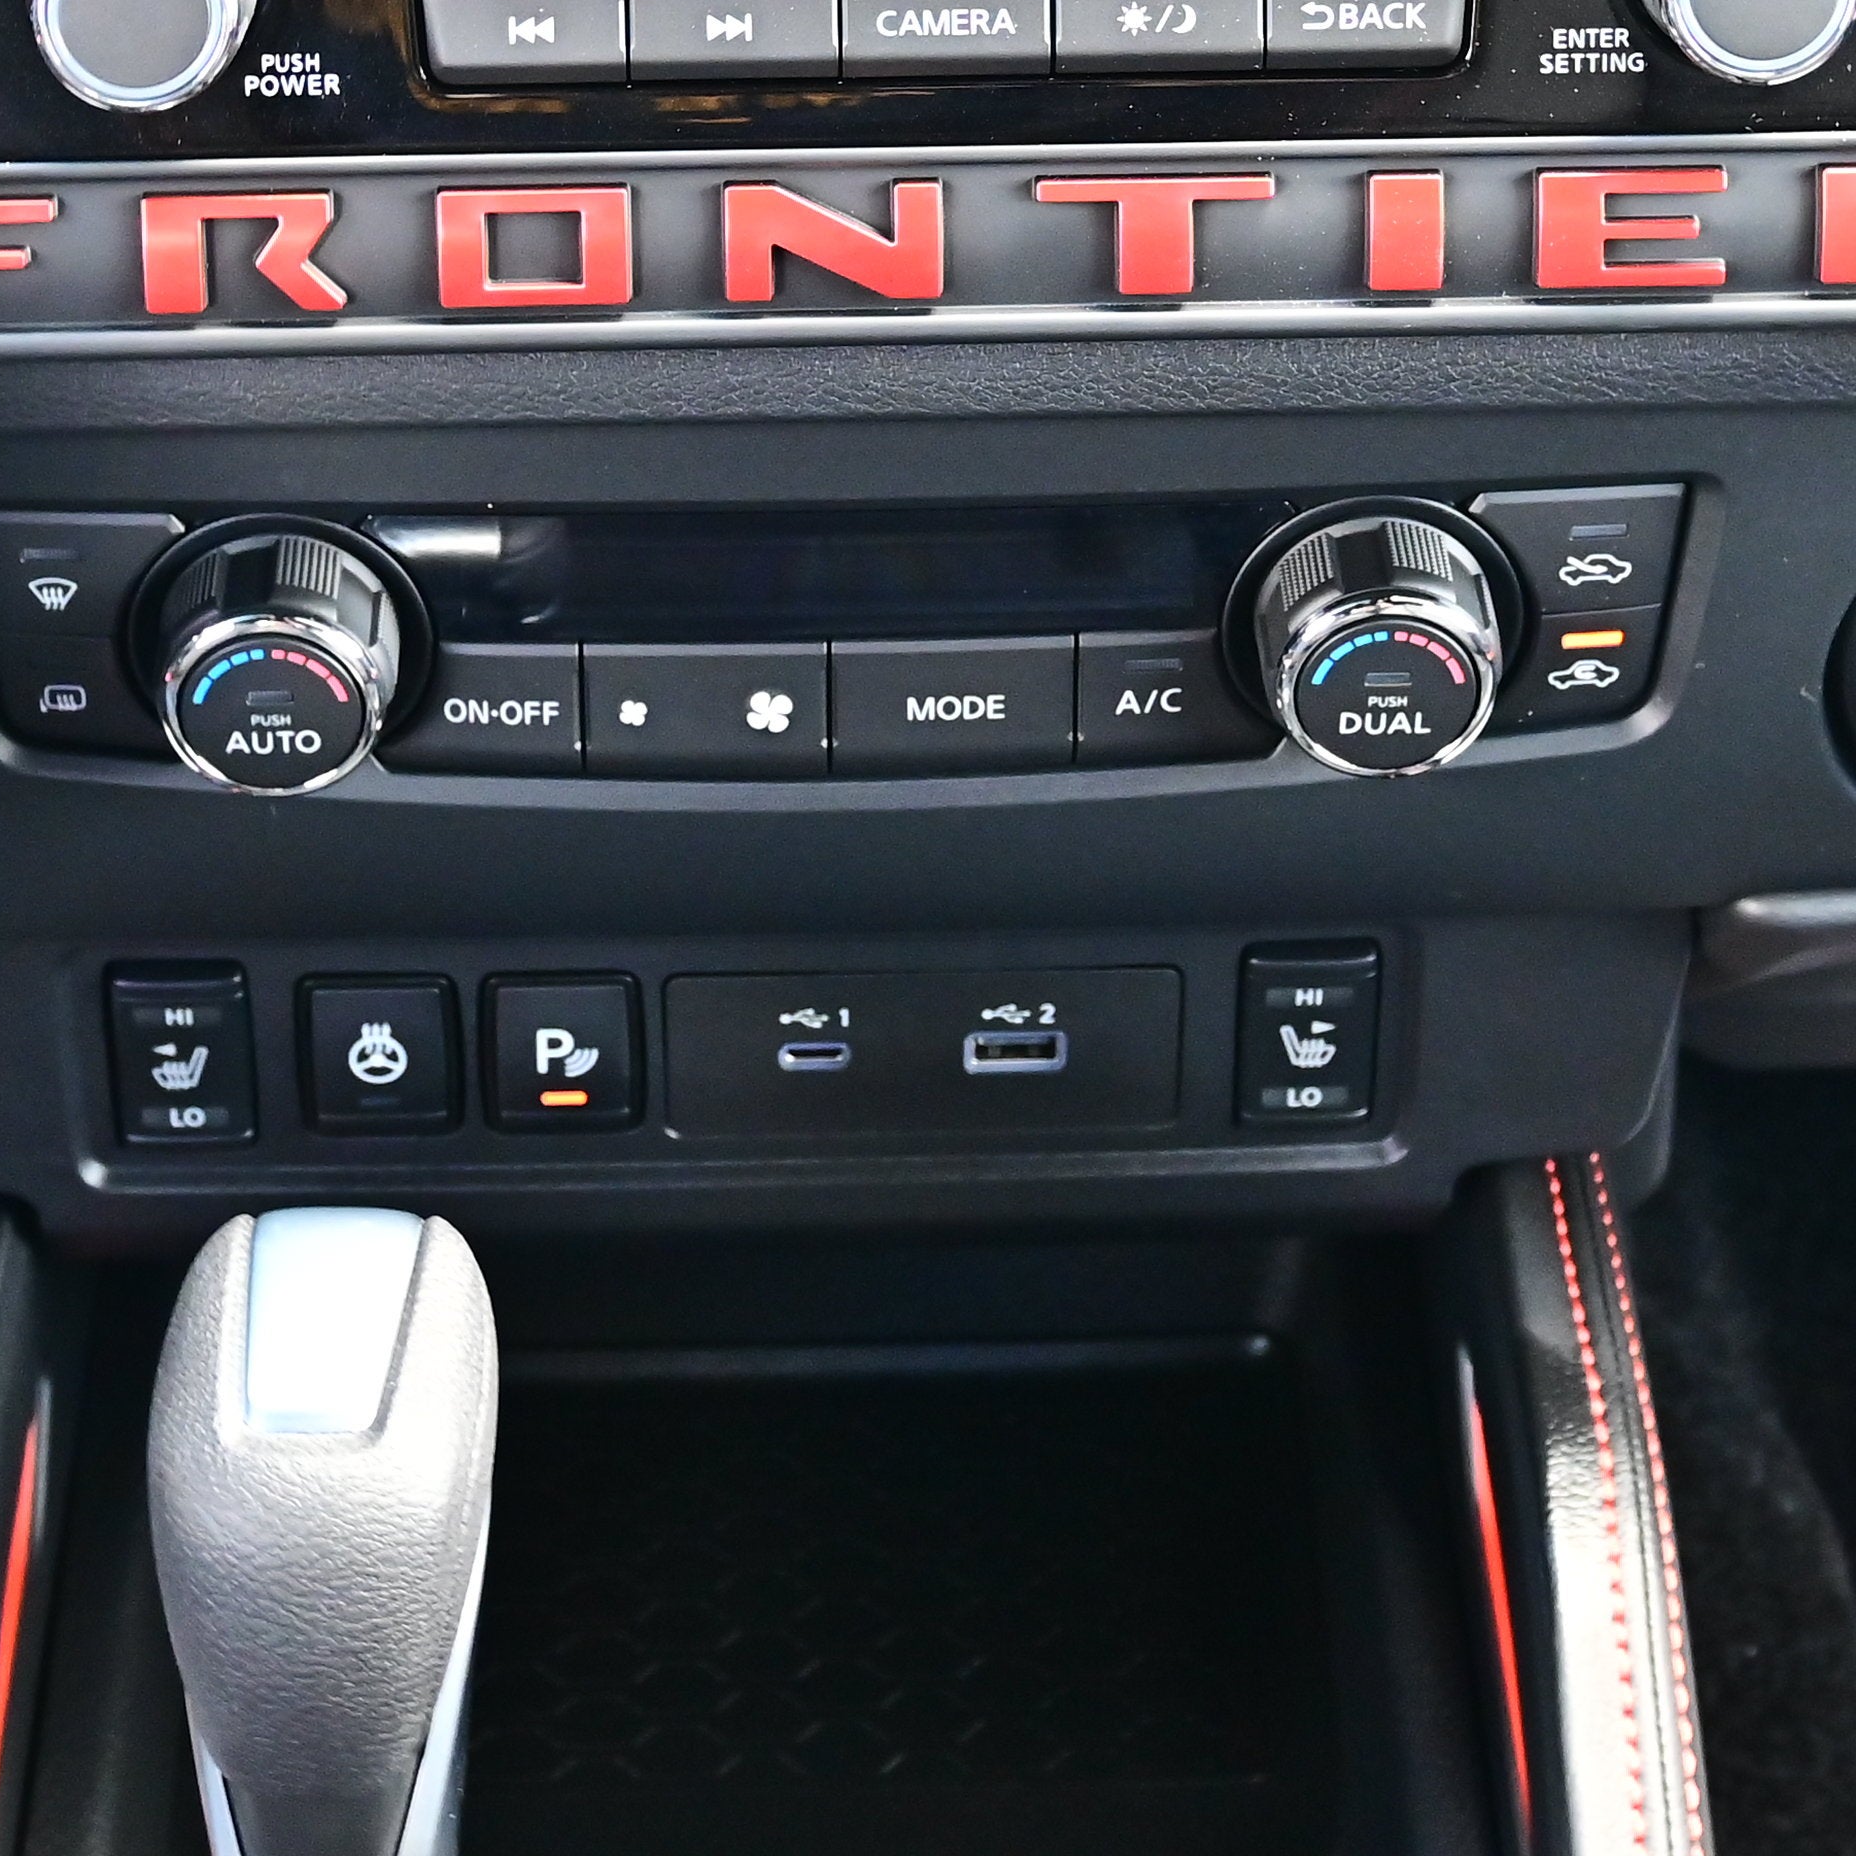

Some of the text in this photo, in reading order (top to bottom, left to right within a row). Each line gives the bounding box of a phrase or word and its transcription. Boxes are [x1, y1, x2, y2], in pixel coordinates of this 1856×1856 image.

[876, 9, 1016, 36] CAMERA
[1339, 3, 1426, 29] BACK
[1553, 28, 1629, 49] ENTER
[261, 53, 320, 73] PUSH
[1540, 53, 1644, 74] SETTING
[245, 74, 340, 97] POWER
[907, 695, 1005, 720] MODE
[1116, 688, 1181, 715] A/C
[1368, 696, 1407, 707] PUSH
[251, 715, 291, 726] PUSH
[1339, 712, 1431, 735] DUAL
[226, 730, 321, 754] AUTO
[1295, 989, 1323, 1006] HI
[165, 1009, 193, 1025] HI
[839, 1009, 849, 1027] 1
[1040, 1003, 1055, 1024] 2
[1287, 1087, 1323, 1107] LO
[170, 1108, 206, 1127] LO
